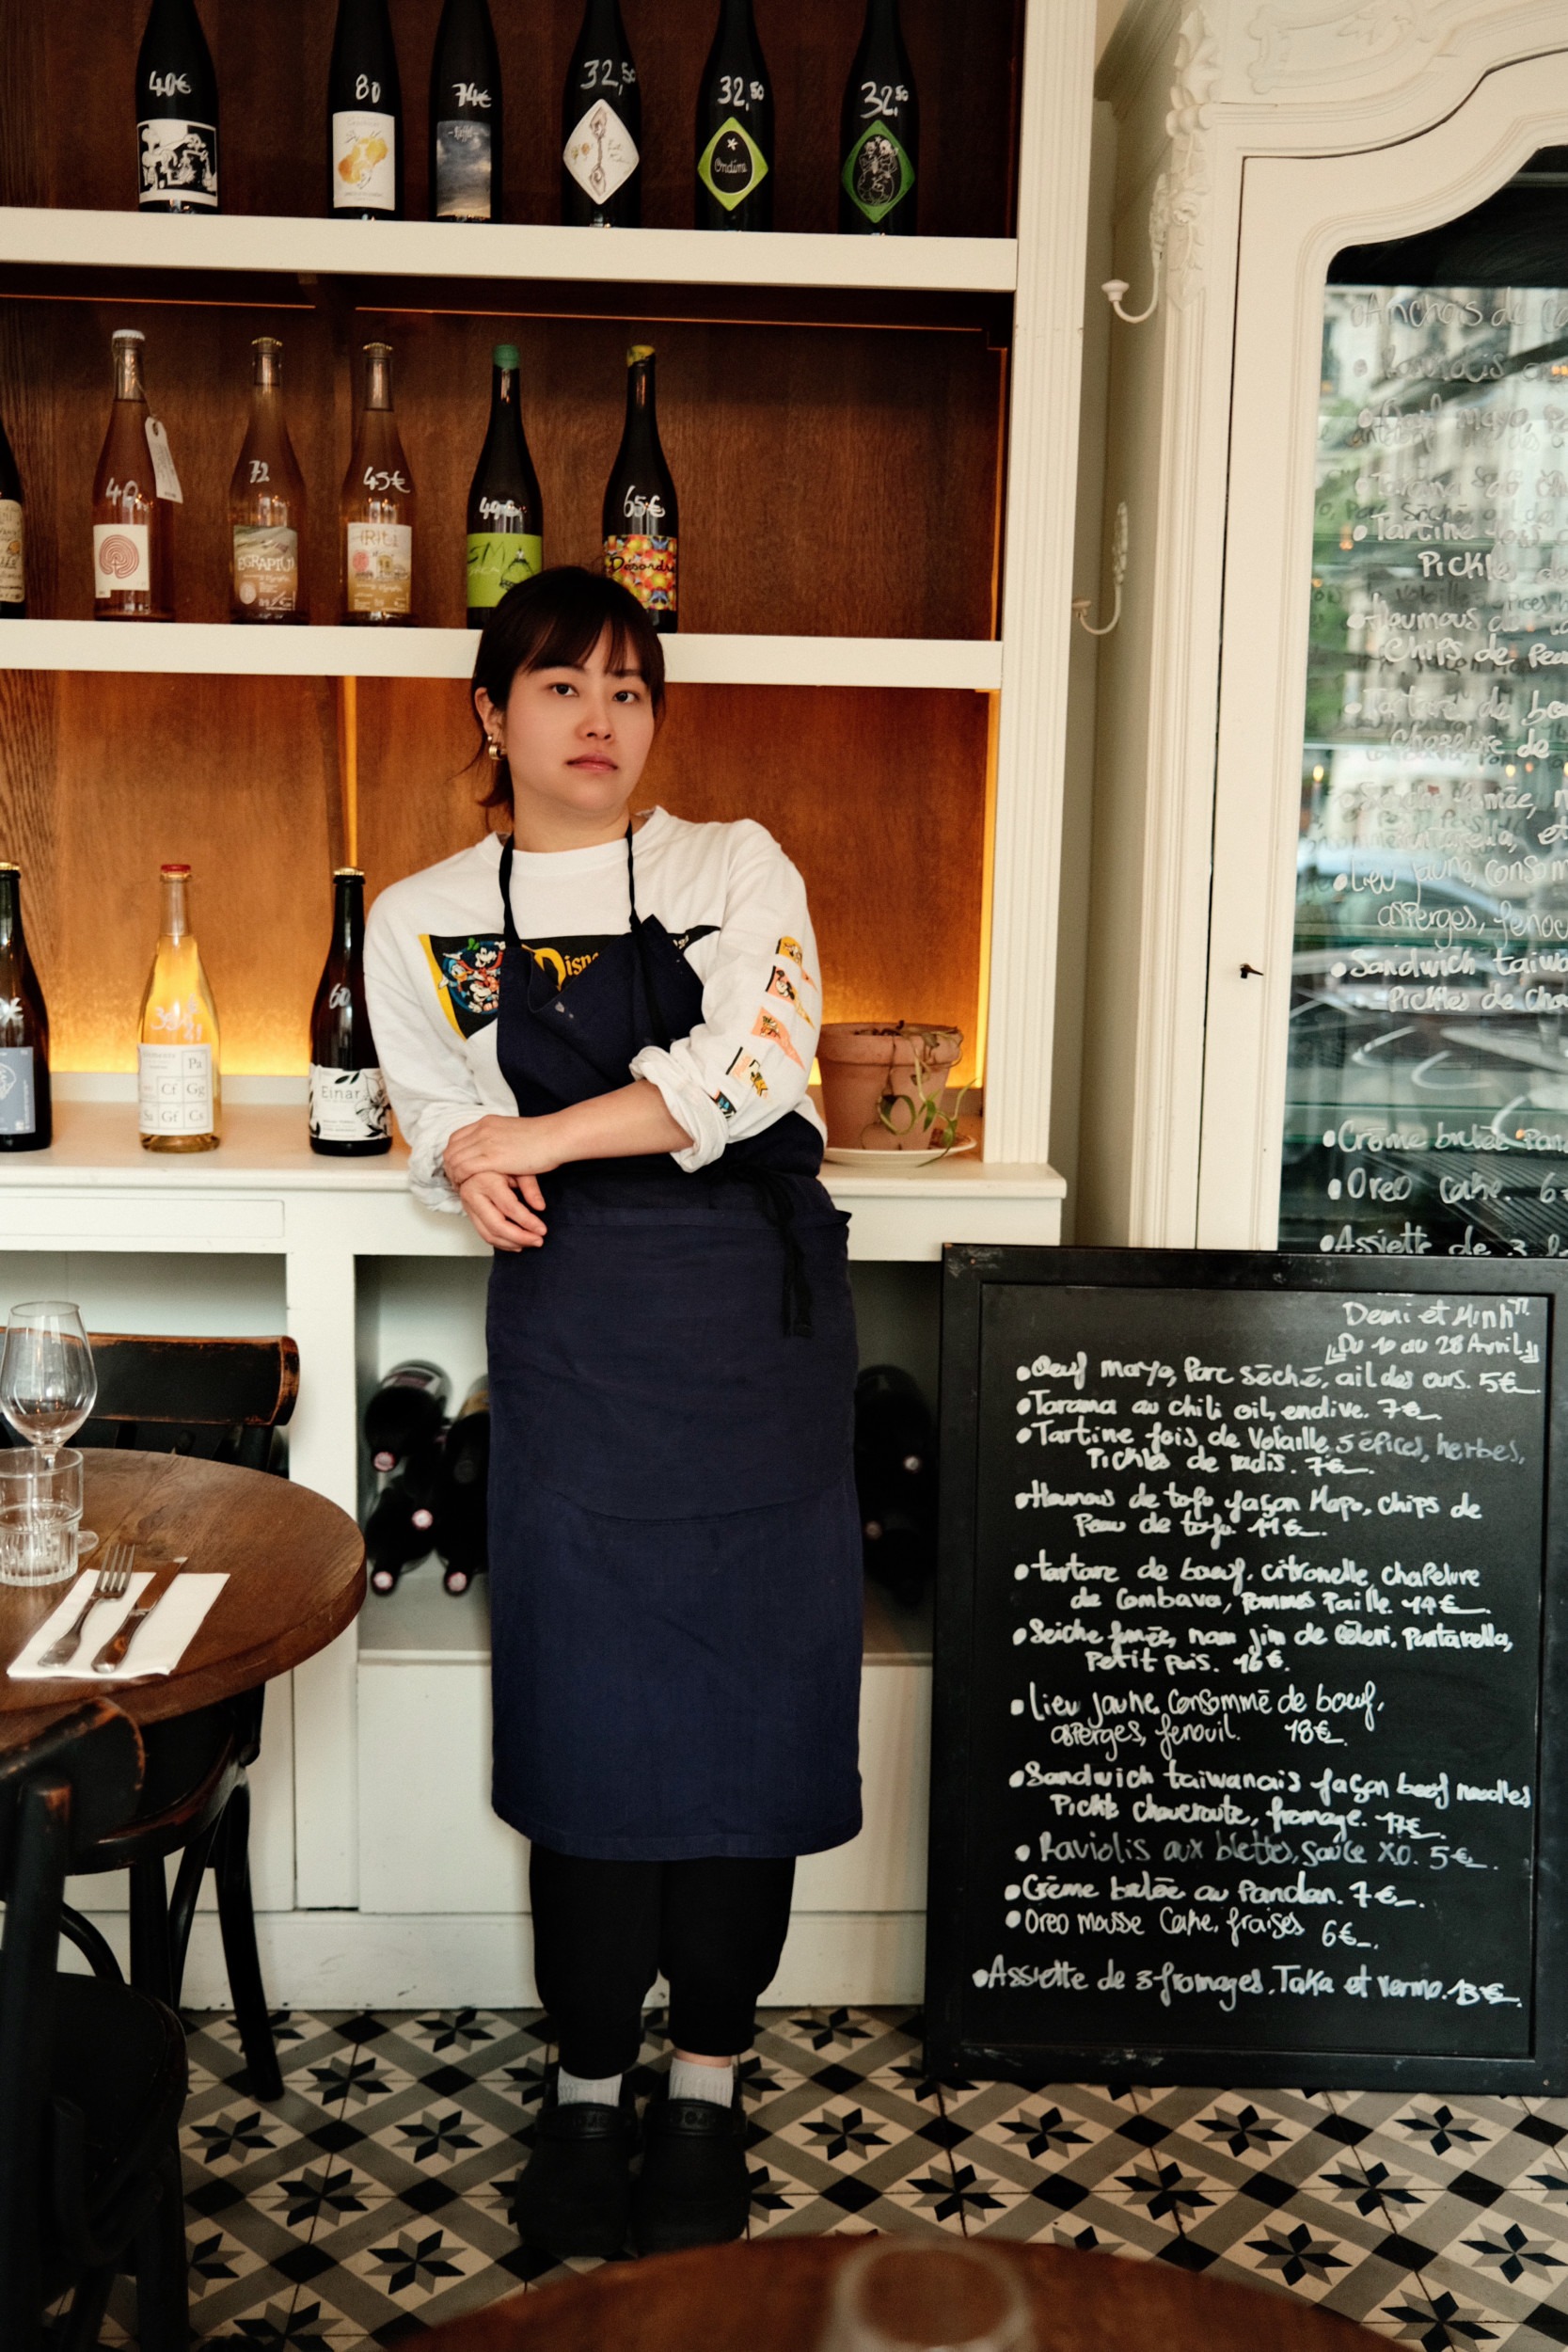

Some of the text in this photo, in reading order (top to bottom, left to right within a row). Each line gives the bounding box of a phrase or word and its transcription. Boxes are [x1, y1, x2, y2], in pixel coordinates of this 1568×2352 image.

[363, 467, 410, 494] 45€
[624, 485, 665, 518] 65€
[1370, 511, 1476, 542] Tartine
[1474, 632, 1516, 666] de
[1516, 727, 1550, 759] de
[1350, 947, 1476, 978] Sandwich
[329, 983, 352, 1009] 60
[1481, 982, 1515, 1010] de
[321, 1086, 361, 1101] Einar
[1347, 1168, 1411, 1203] Oreo
[1449, 1225, 1492, 1255] de
[1418, 1298, 1451, 1326] et
[1435, 1336, 1464, 1355] 28
[1030, 1415, 1135, 1446] Tartine
[1207, 1422, 1241, 1449] de
[1186, 1445, 1220, 1473] de
[1129, 1483, 1161, 1509] de
[1449, 1492, 1483, 1519] de
[1139, 1511, 1172, 1534] de
[1137, 1555, 1169, 1581] de
[1070, 1586, 1102, 1610] de
[1293, 1621, 1329, 1646] de
[1277, 1683, 1307, 1714] de
[1024, 1760, 1155, 1788] Sandwich
[1039, 1831, 1150, 1864] Raviolis
[1164, 1839, 1203, 1862] aux
[1194, 1885, 1228, 1901] au
[1322, 1920, 1357, 1947] 6€
[1097, 1959, 1126, 1991] de
[1343, 1963, 1372, 1998] et
